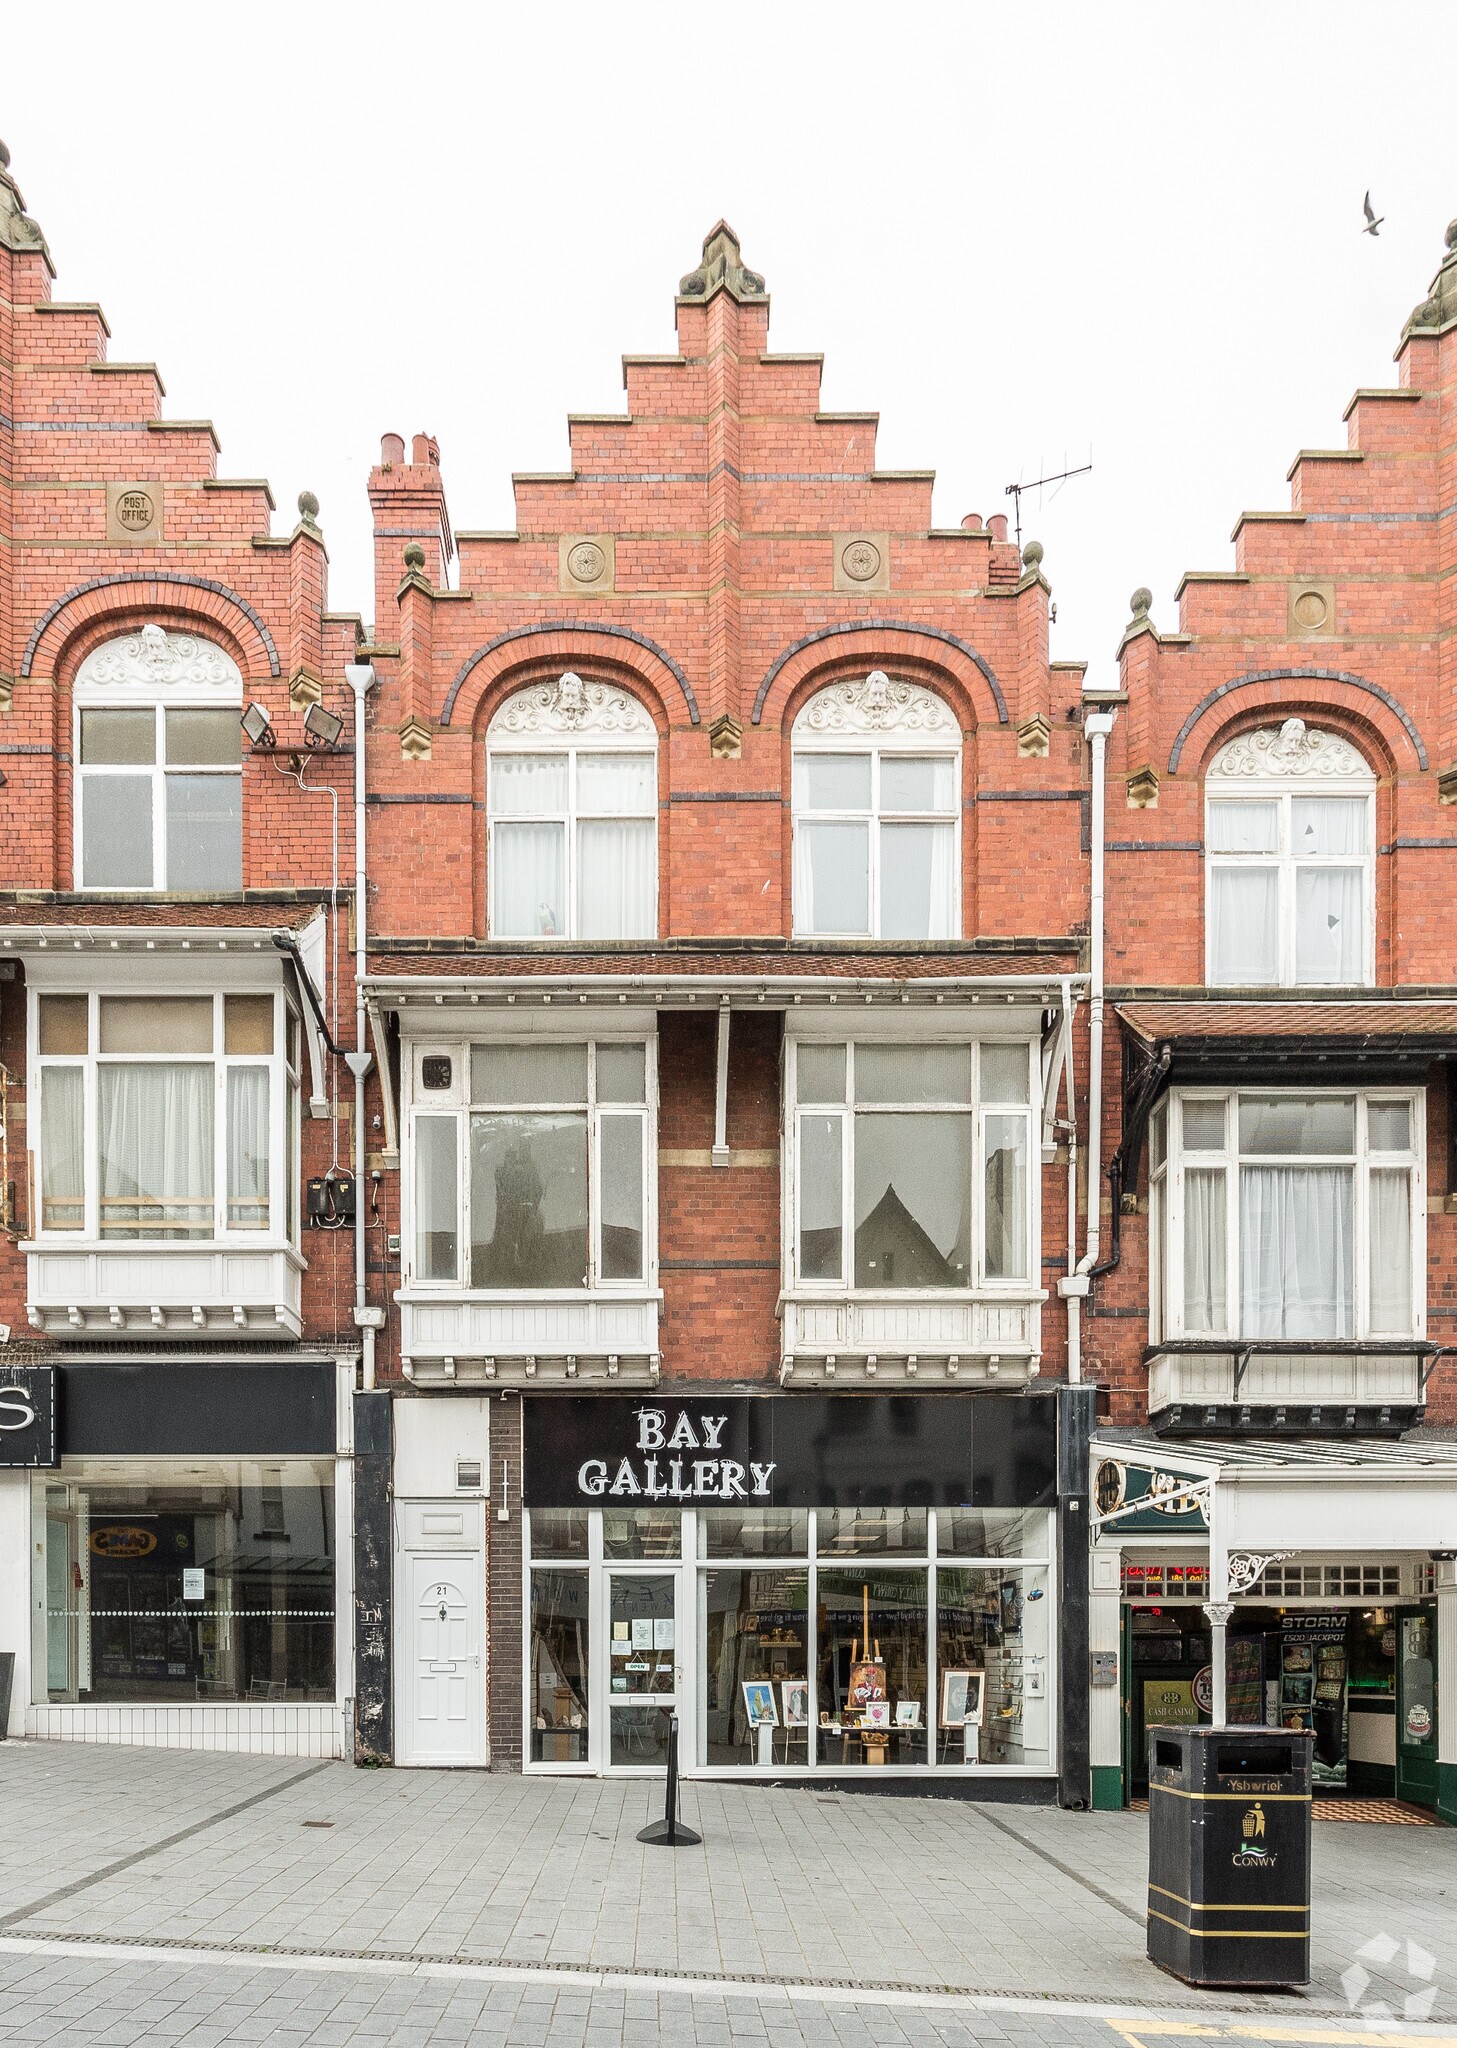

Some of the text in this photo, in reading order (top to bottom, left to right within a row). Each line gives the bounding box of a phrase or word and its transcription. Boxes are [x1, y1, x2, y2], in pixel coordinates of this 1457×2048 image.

[124, 497, 146, 508] POST
[122, 510, 149, 521] OFFICE
[632, 1407, 728, 1453] BAY
[578, 1455, 777, 1500] GALLERY
[436, 1586, 447, 1596] 21
[1281, 1616, 1348, 1629] STORM
[1307, 1633, 1346, 1642] JACKPOT
[1148, 1707, 1194, 1717] CASH CASINO
[1230, 1780, 1280, 1792] Ysbwriel
[1232, 1855, 1276, 1866] CONWY
